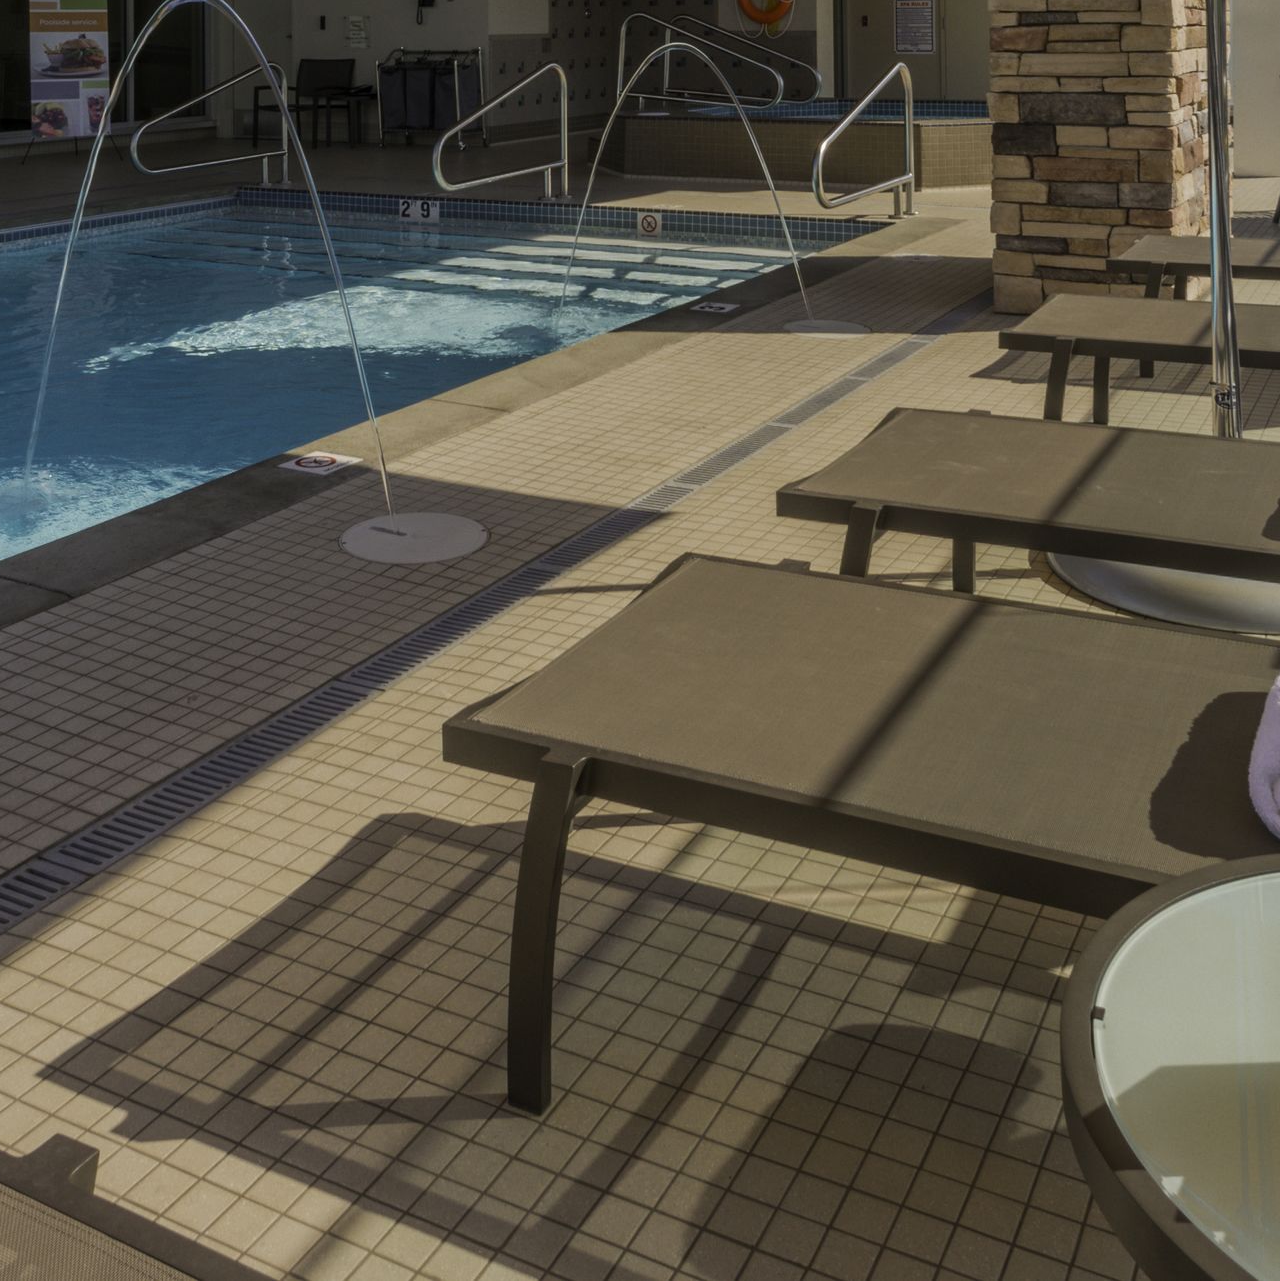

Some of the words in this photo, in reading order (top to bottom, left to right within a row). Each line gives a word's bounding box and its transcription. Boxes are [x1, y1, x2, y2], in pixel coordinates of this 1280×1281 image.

[39, 18, 71, 26] Poolside
[401, 200, 411, 218] 2
[420, 201, 430, 218] 9
